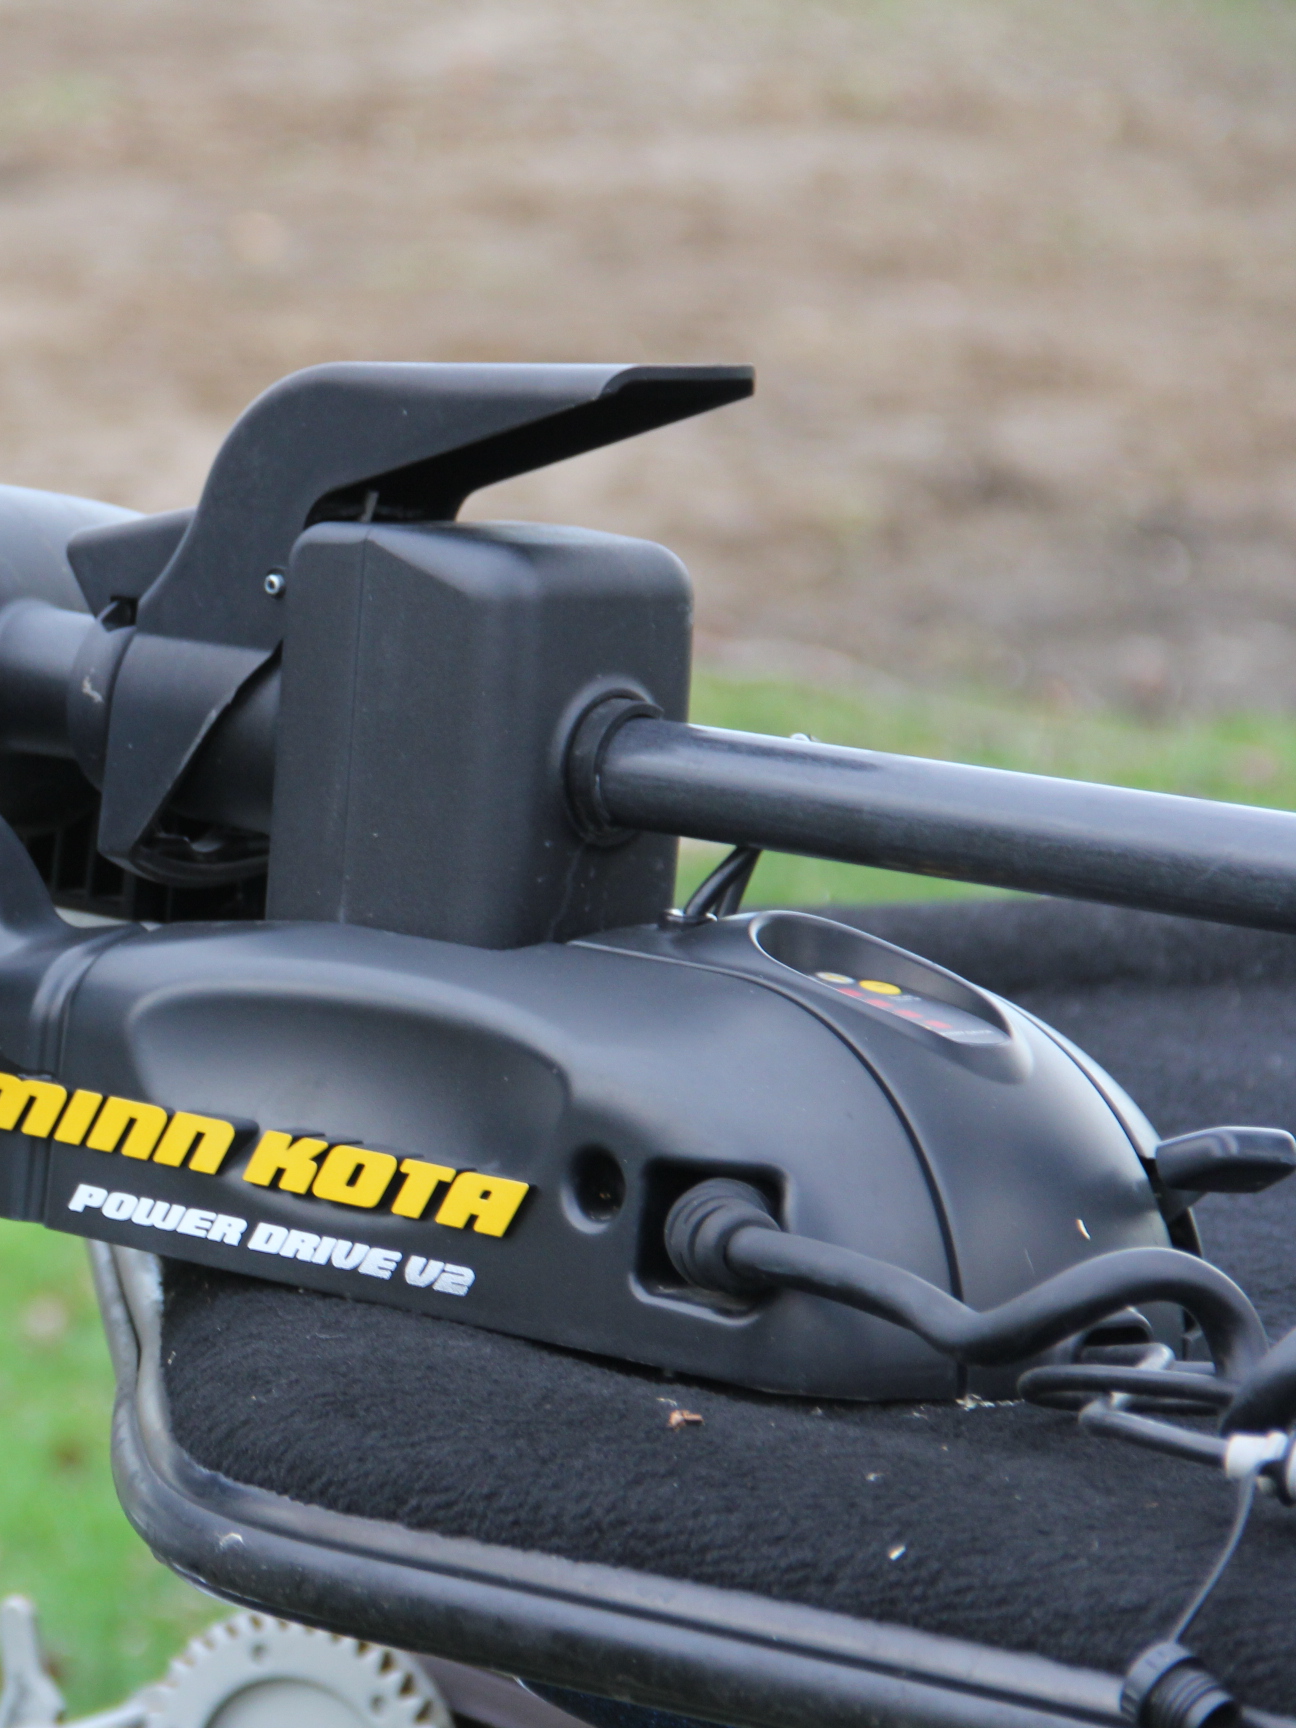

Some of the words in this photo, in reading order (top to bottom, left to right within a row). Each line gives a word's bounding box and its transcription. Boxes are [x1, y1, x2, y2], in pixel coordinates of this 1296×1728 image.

[243, 1130, 530, 1238] KOTA
[68, 1183, 248, 1246] POWER
[246, 1221, 403, 1280] DRIVE
[405, 1255, 476, 1296] V2
